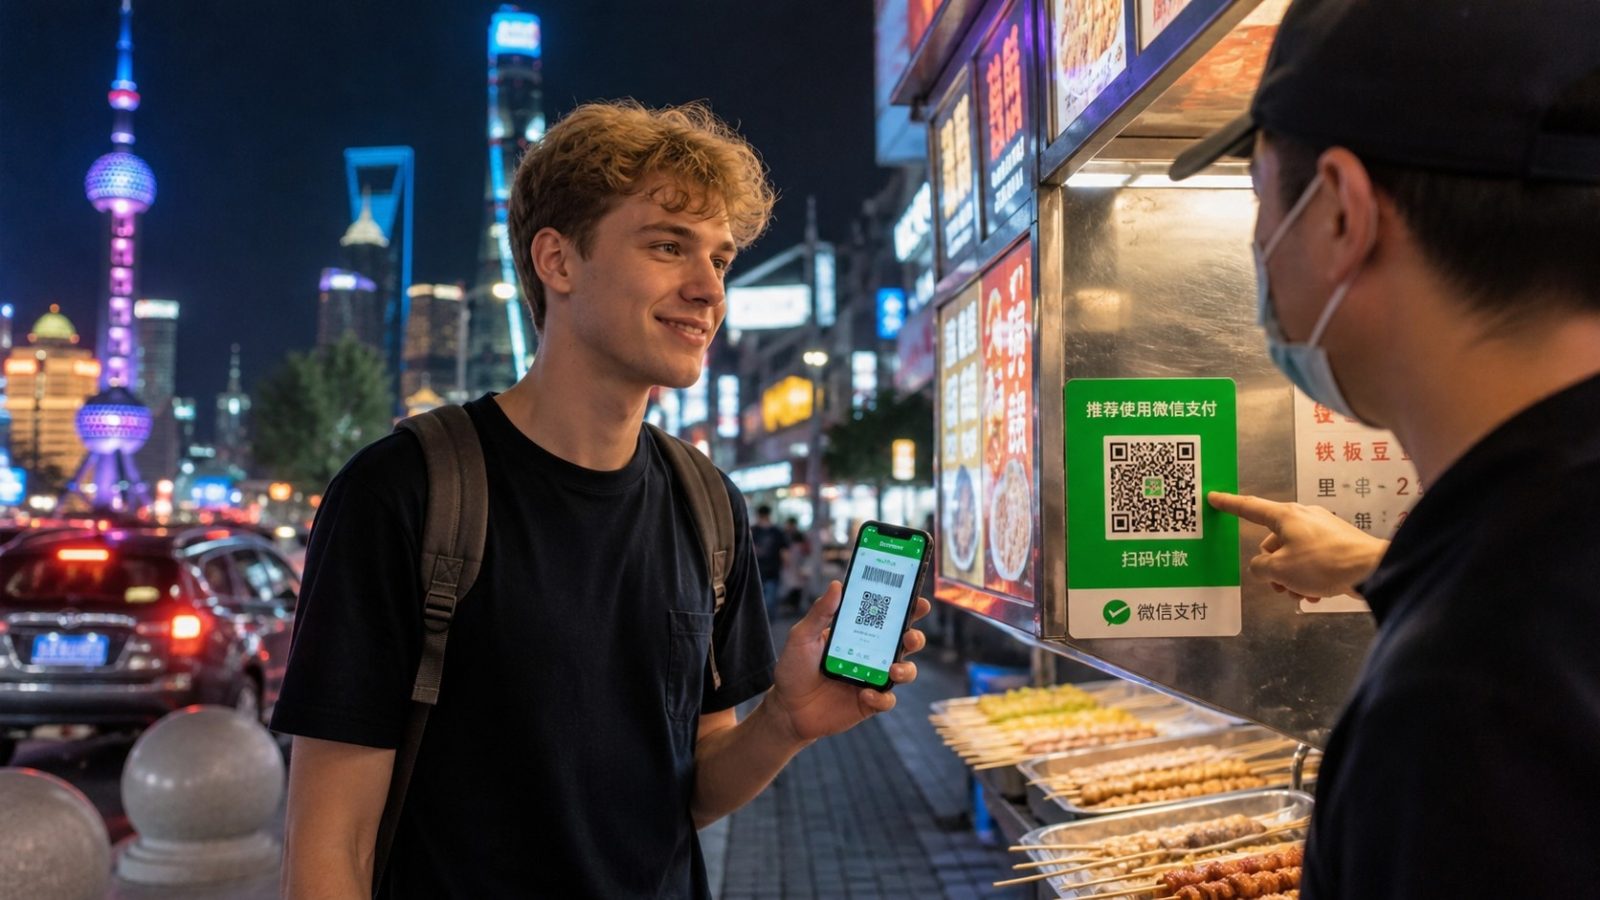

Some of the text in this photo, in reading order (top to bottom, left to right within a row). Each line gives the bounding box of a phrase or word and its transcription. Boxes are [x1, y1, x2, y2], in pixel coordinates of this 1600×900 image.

[1086, 400, 1217, 418] 推荐使用微信支付
[1121, 550, 1189, 568] 扫码付款
[1137, 602, 1208, 621] 微信支付
